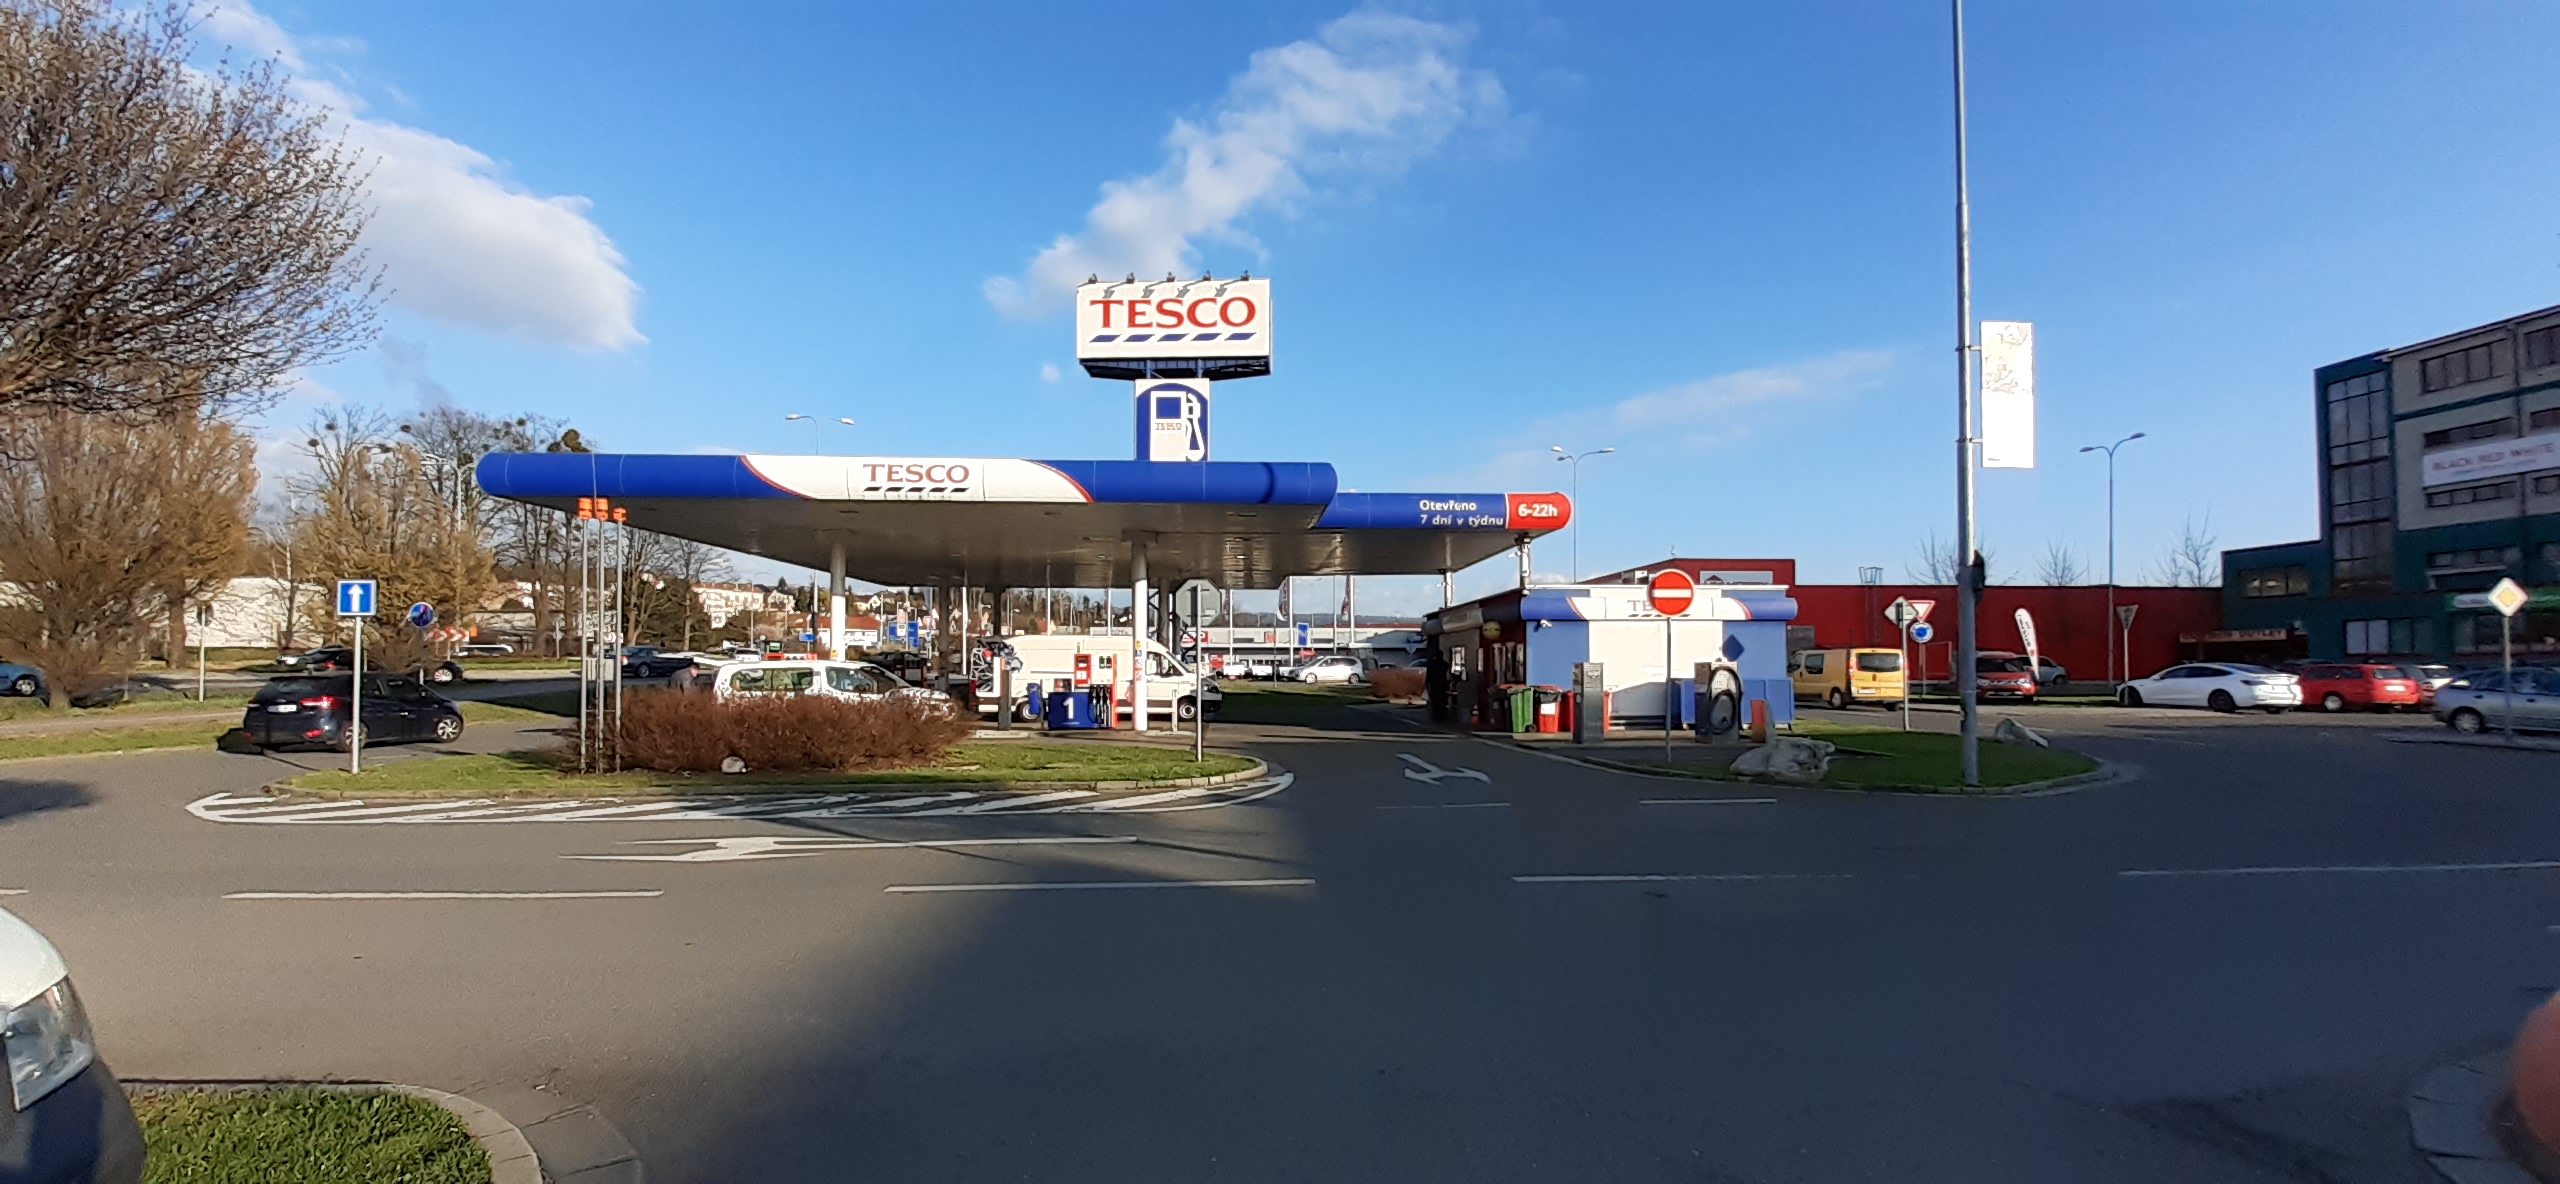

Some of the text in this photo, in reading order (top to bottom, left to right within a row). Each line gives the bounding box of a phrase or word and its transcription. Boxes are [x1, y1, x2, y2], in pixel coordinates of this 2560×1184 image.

[1089, 296, 1257, 329] TESCO
[862, 463, 970, 483] TESCO
[1419, 499, 1477, 511] Otevřeno
[1517, 503, 1558, 517] 6-22h
[1420, 514, 1504, 528] 7 dní v týdnu
[1062, 696, 1075, 720] 1
